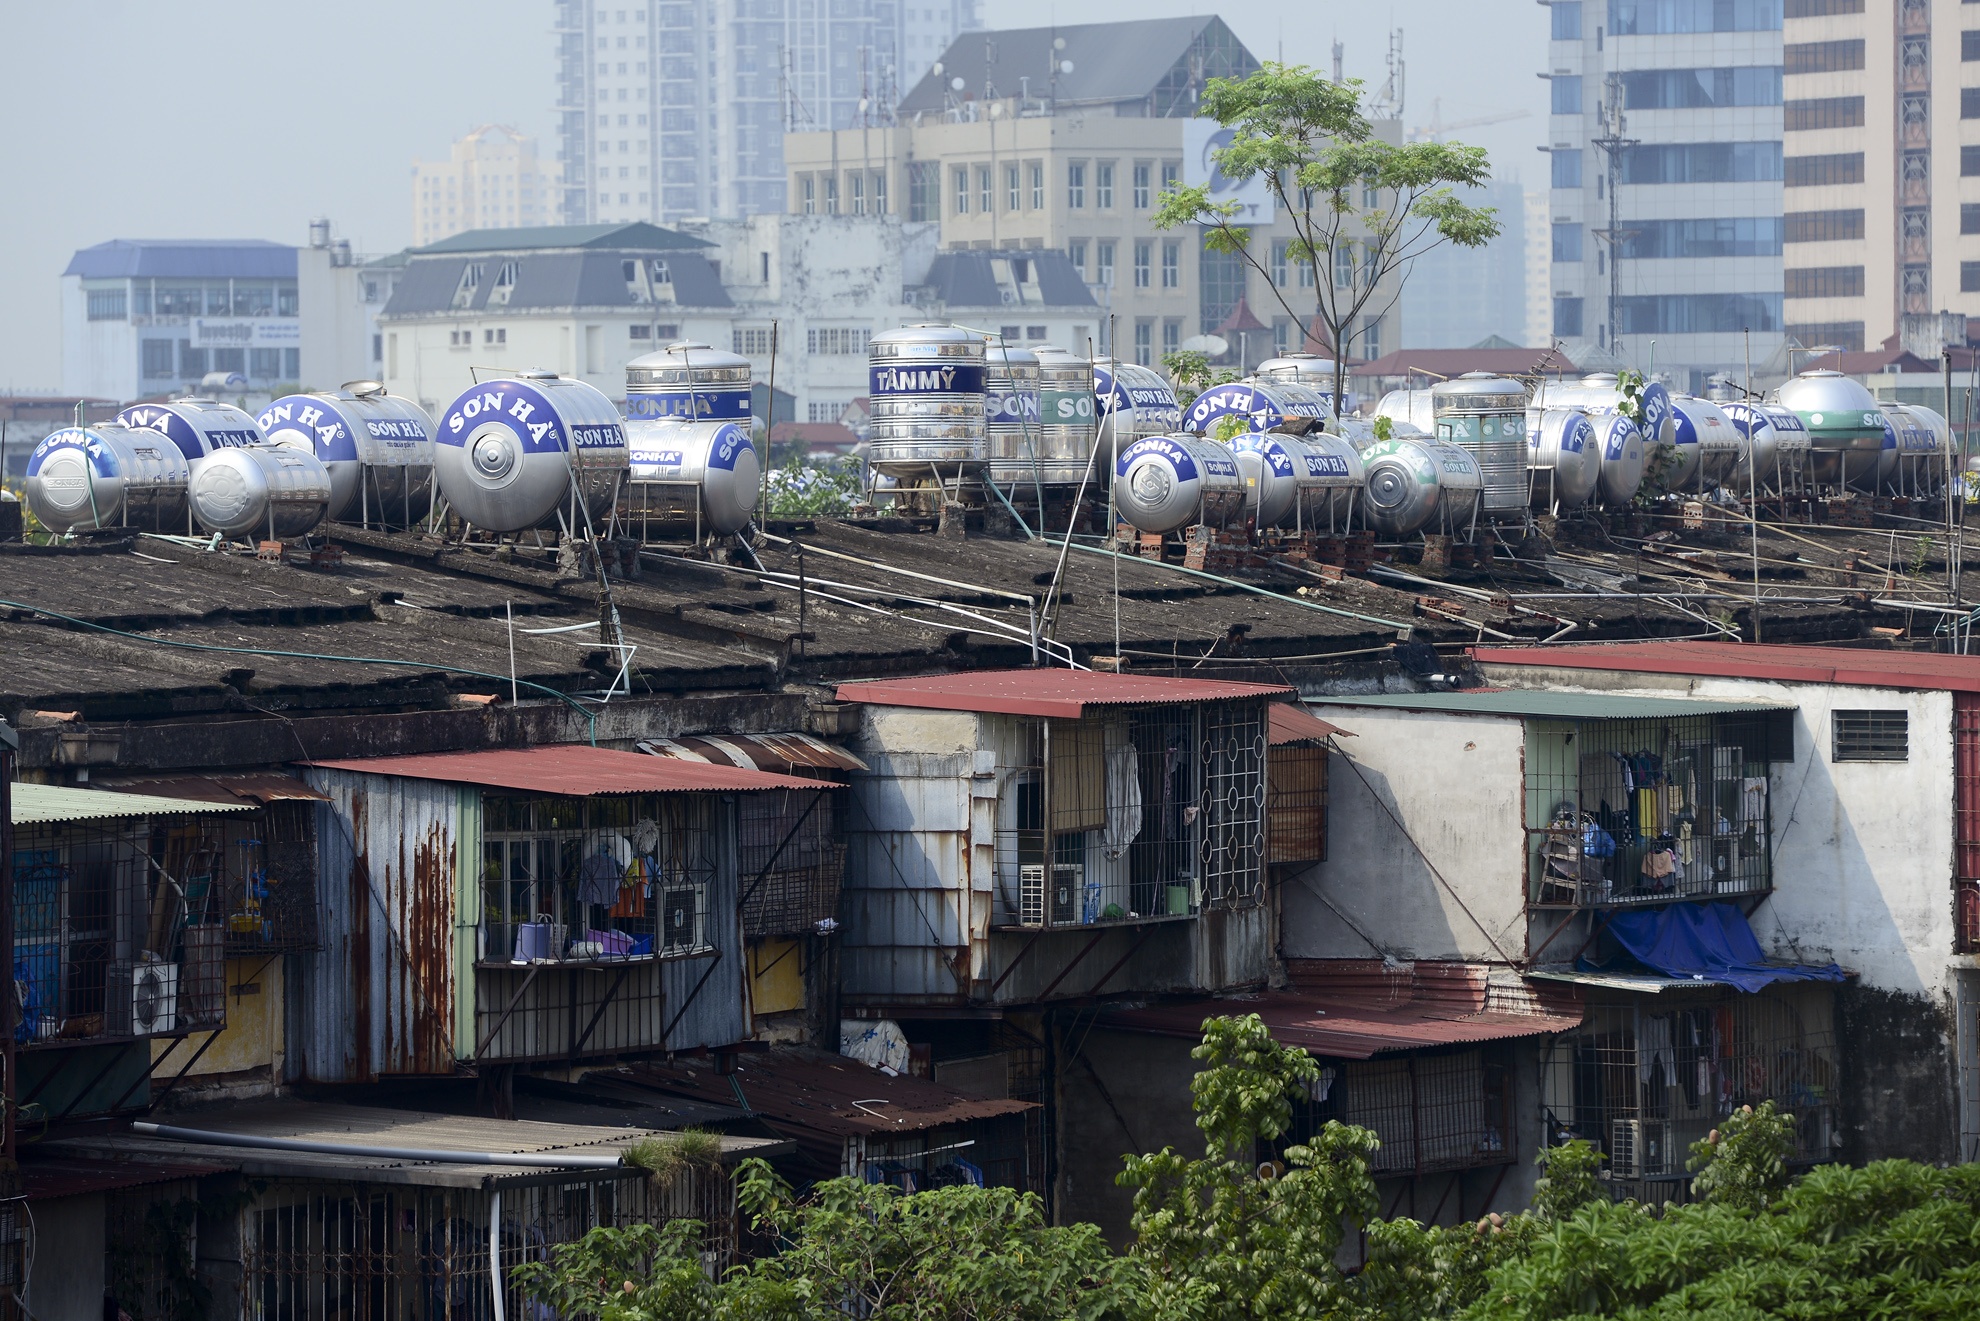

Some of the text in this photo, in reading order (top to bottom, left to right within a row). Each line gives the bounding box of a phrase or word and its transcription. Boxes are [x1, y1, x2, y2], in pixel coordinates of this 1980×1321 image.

[627, 394, 713, 416] SƠN HÀ
[1057, 395, 1094, 418] SƠ
[1184, 392, 1227, 432] SƠN
[117, 409, 149, 429] ÂN
[257, 403, 342, 446] ƠN HÀ
[366, 418, 425, 437] SƠN HÀ
[449, 392, 553, 445] SƠN HÀ
[573, 425, 624, 446] SƠN HÀ
[1122, 440, 1183, 464] SONHA
[1306, 455, 1348, 472] SƠN HÀ
